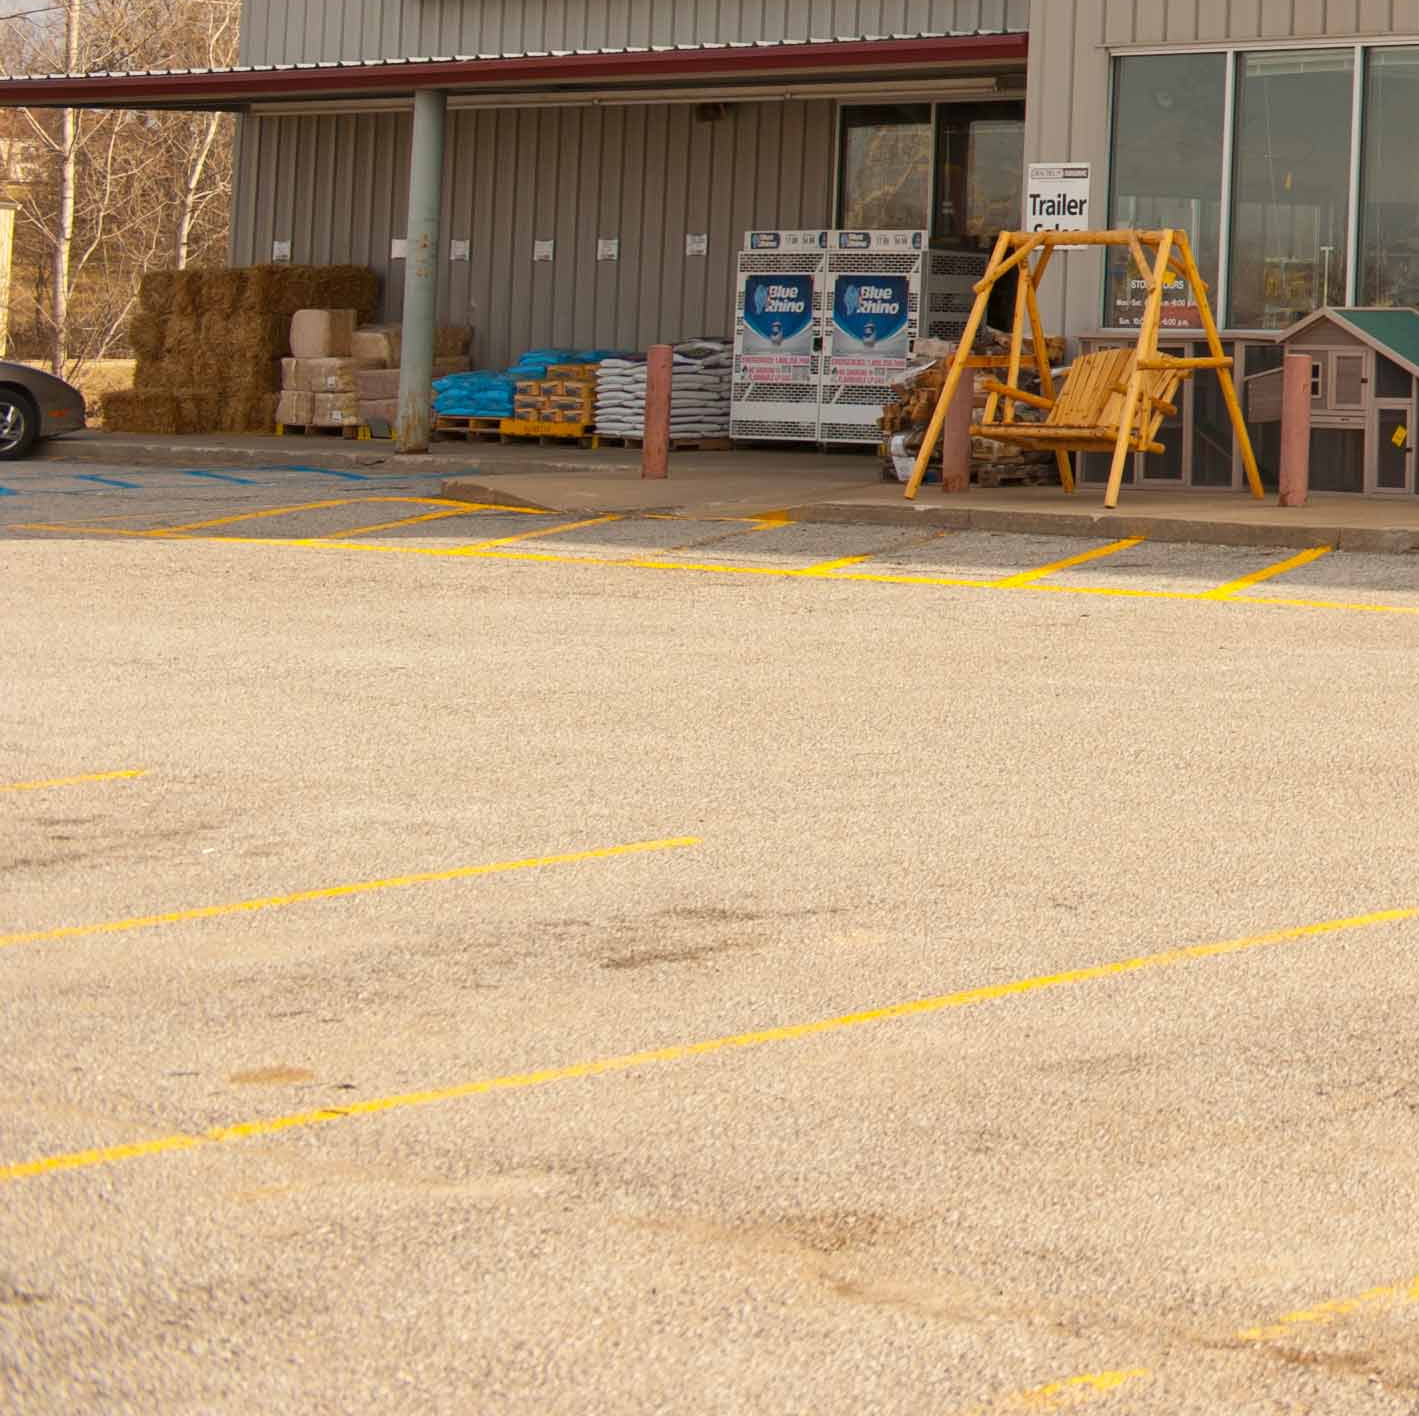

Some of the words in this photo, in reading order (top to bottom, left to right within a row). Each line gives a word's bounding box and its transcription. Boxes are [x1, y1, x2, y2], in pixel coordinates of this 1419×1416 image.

[1029, 193, 1087, 216] Trailer
[768, 285, 799, 299] Blue
[860, 286, 893, 299] Blue
